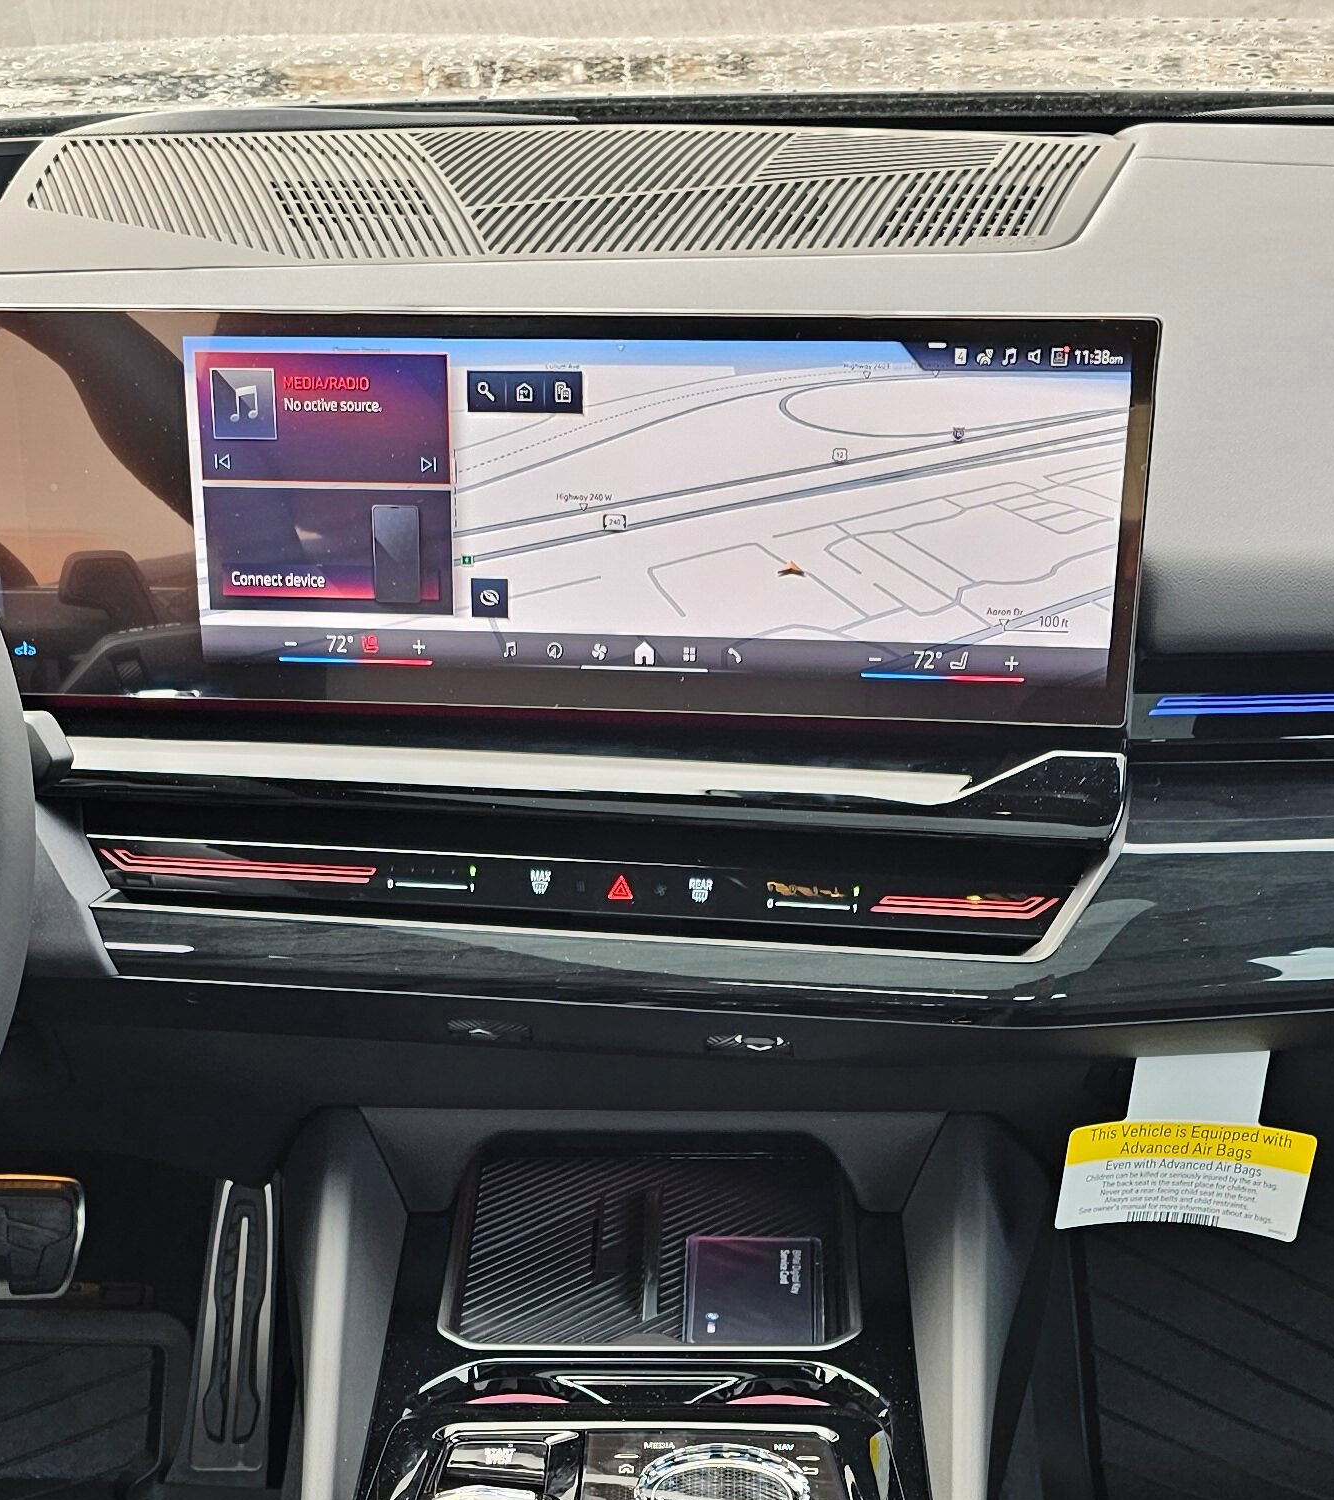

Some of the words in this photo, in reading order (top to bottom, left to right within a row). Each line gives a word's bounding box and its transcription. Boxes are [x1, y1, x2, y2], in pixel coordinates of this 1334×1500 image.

[1074, 350, 1124, 365] 11:38am
[283, 376, 370, 390] MEDIA/RADIO
[284, 398, 301, 411] No
[303, 398, 337, 412] active
[556, 493, 588, 502] Highway
[589, 493, 603, 501] 240
[604, 493, 613, 501] W
[231, 571, 283, 587] Connect
[285, 572, 326, 588] device
[987, 607, 1011, 616] Aaron
[1013, 607, 1023, 616] Dr
[1039, 616, 1060, 628] 100
[530, 869, 552, 882] MAX
[688, 877, 714, 891] REAR
[1091, 1127, 1117, 1141] This
[1121, 1125, 1171, 1137] Vehicle
[1175, 1125, 1187, 1137] is
[1191, 1125, 1260, 1143] Equipped
[1263, 1133, 1293, 1148] with
[1120, 1141, 1189, 1154] Advanced
[1192, 1142, 1213, 1156] Air
[1216, 1144, 1252, 1161] Bags
[1105, 1160, 1131, 1170] Even
[1133, 1159, 1156, 1169] with
[1158, 1159, 1213, 1171] Advanced
[1215, 1162, 1231, 1173] Air
[1233, 1163, 1262, 1178] Bags
[1085, 1172, 1114, 1182] Children
[1140, 1170, 1159, 1178] killed
[1169, 1171, 1201, 1180] seriously
[1203, 1173, 1227, 1182] injured
[1229, 1175, 1237, 1185] by
[1239, 1177, 1251, 1185] the
[1252, 1179, 1262, 1187] air
[1117, 1179, 1133, 1187] back
[1171, 1180, 1193, 1188] safest
[1194, 1181, 1214, 1191] place
[1215, 1182, 1226, 1190] for
[1100, 1188, 1120, 1196] Never
[1121, 1187, 1133, 1196] put
[1181, 1187, 1198, 1196] child
[1199, 1189, 1215, 1197] seat
[1224, 1191, 1236, 1199] the
[1104, 1196, 1128, 1204] Always
[1160, 1195, 1178, 1203] belts
[1179, 1196, 1193, 1204] and
[1194, 1196, 1212, 1205] child
[1078, 1207, 1092, 1215] See
[1179, 1204, 1220, 1214] information
[1222, 1209, 1242, 1218] about
[643, 1441, 676, 1450] MEDIA
[774, 1443, 795, 1451] NAV
